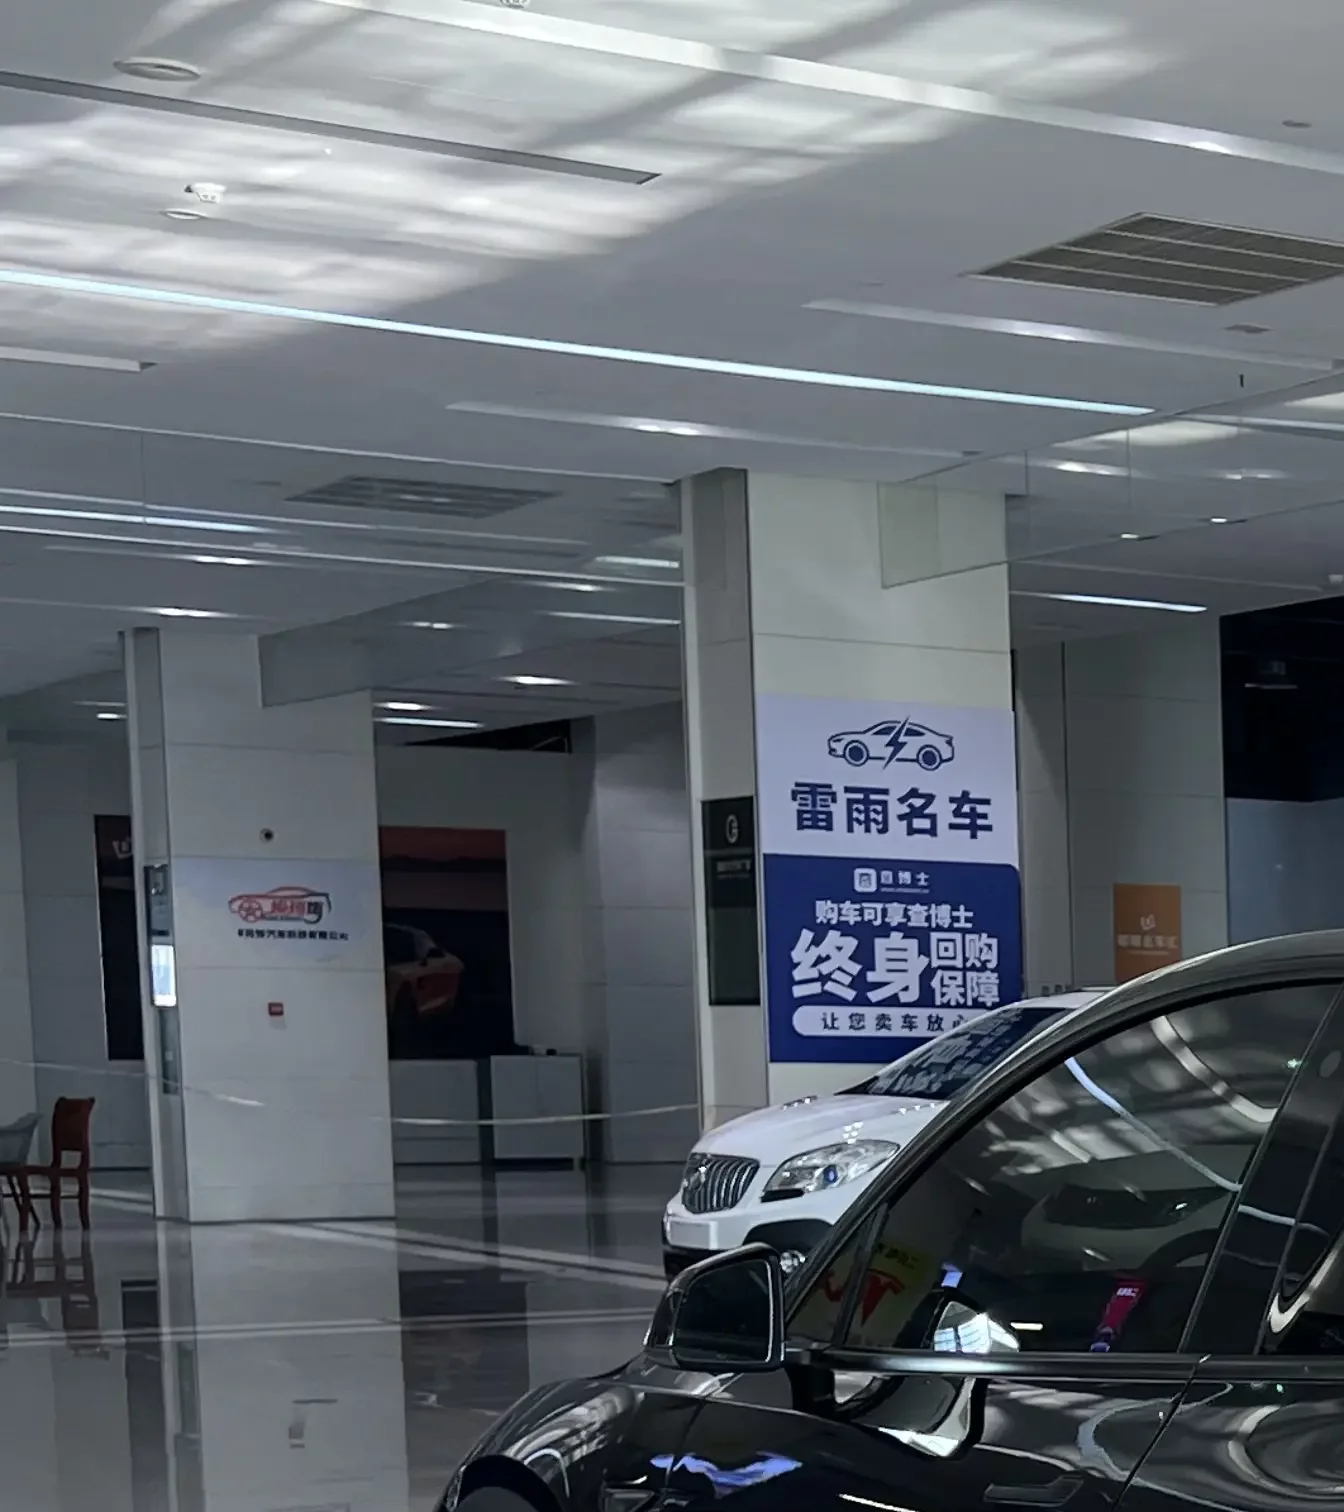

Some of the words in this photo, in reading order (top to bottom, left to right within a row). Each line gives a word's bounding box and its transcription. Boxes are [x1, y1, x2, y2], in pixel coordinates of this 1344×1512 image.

[791, 782, 993, 839] 雷雨名车
[815, 900, 974, 929] 购车可享查博士
[791, 928, 930, 1003] 终身
[930, 931, 999, 969] 回购
[930, 969, 1000, 1007] 保障
